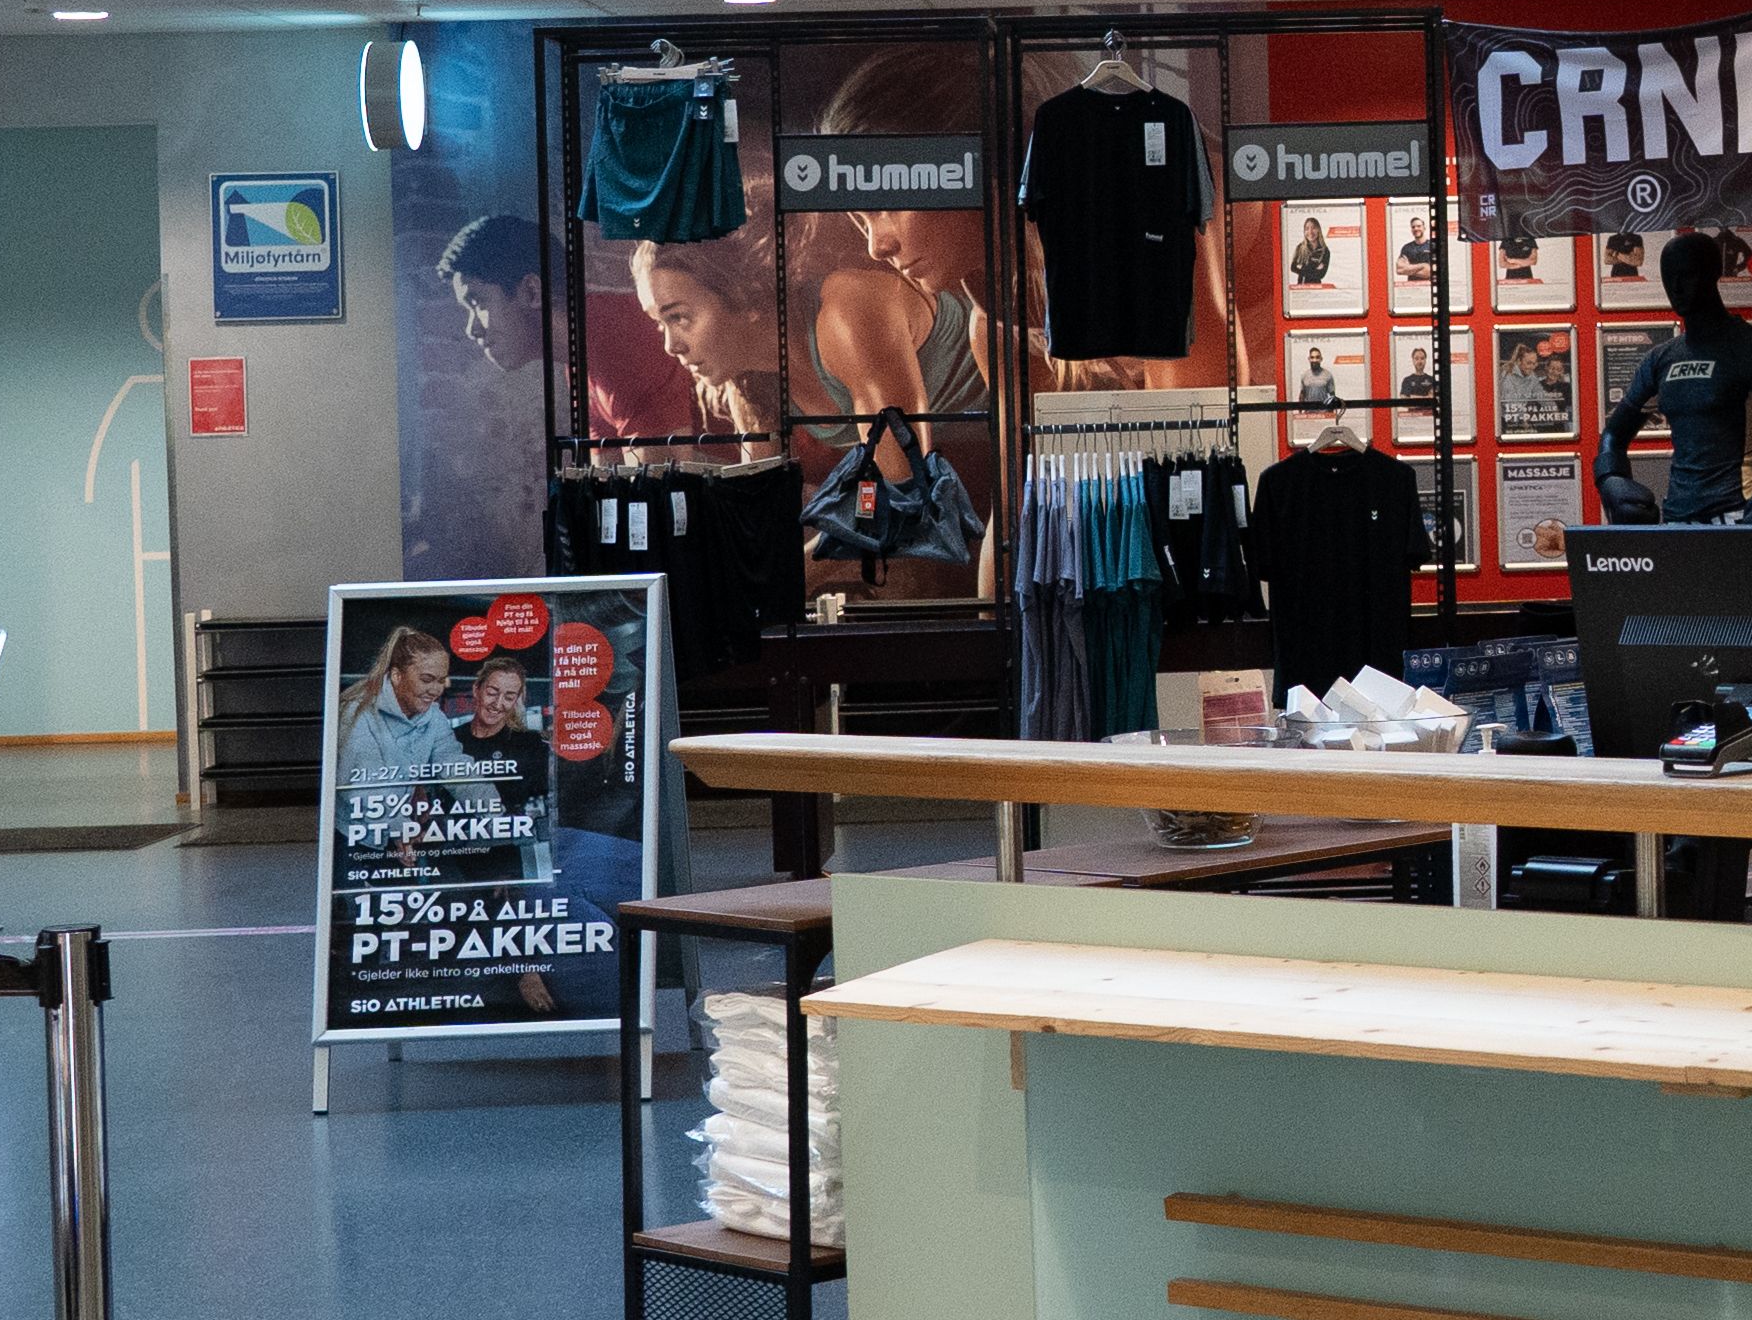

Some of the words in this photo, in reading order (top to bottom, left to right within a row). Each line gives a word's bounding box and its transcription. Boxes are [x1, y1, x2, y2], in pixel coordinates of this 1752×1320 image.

[1277, 140, 1420, 180] hummel
[828, 152, 973, 191] hummel
[224, 250, 321, 268] Miljøfyrtårn
[1669, 361, 1711, 380] CRNR
[1504, 412, 1569, 422] PT-PAKKER
[1507, 468, 1570, 478] MASSASJE
[1585, 552, 1654, 573] Lenovo
[567, 643, 581, 653] din
[585, 643, 598, 652] PT
[559, 656, 569, 665] få
[572, 656, 597, 666] hjelp
[564, 667, 576, 676] nå
[579, 666, 597, 676] ditt
[558, 679, 581, 688] mål!
[562, 711, 600, 719] Tilbudet
[565, 721, 598, 730] gjelder
[625, 692, 636, 758] ATHLETICA
[570, 731, 591, 740] også
[560, 741, 604, 751] massasje.
[350, 766, 403, 782] 21.-27.
[409, 760, 518, 778] SEPTEMBER
[625, 762, 635, 782] SiO
[349, 794, 413, 819] 15%
[417, 799, 445, 816] PÅ
[450, 798, 502, 814] ALLE
[348, 815, 534, 847] PT-PAKKER
[387, 848, 404, 859] ikke
[406, 847, 426, 857] intro
[428, 849, 439, 859] og
[442, 846, 490, 856] enkelttimer
[348, 870, 369, 880] SiO
[371, 867, 441, 879] ATHLETICA
[354, 891, 445, 926] 15%
[450, 900, 489, 922] PÅ
[496, 898, 569, 920] ALLE
[352, 921, 615, 963] PT-PAKKER
[405, 967, 429, 979] ikke
[433, 966, 461, 978] intro
[464, 967, 480, 978] og
[483, 963, 555, 976] enkelttimer.
[351, 999, 380, 1013] SiO
[384, 994, 485, 1011] ATHLETICA
